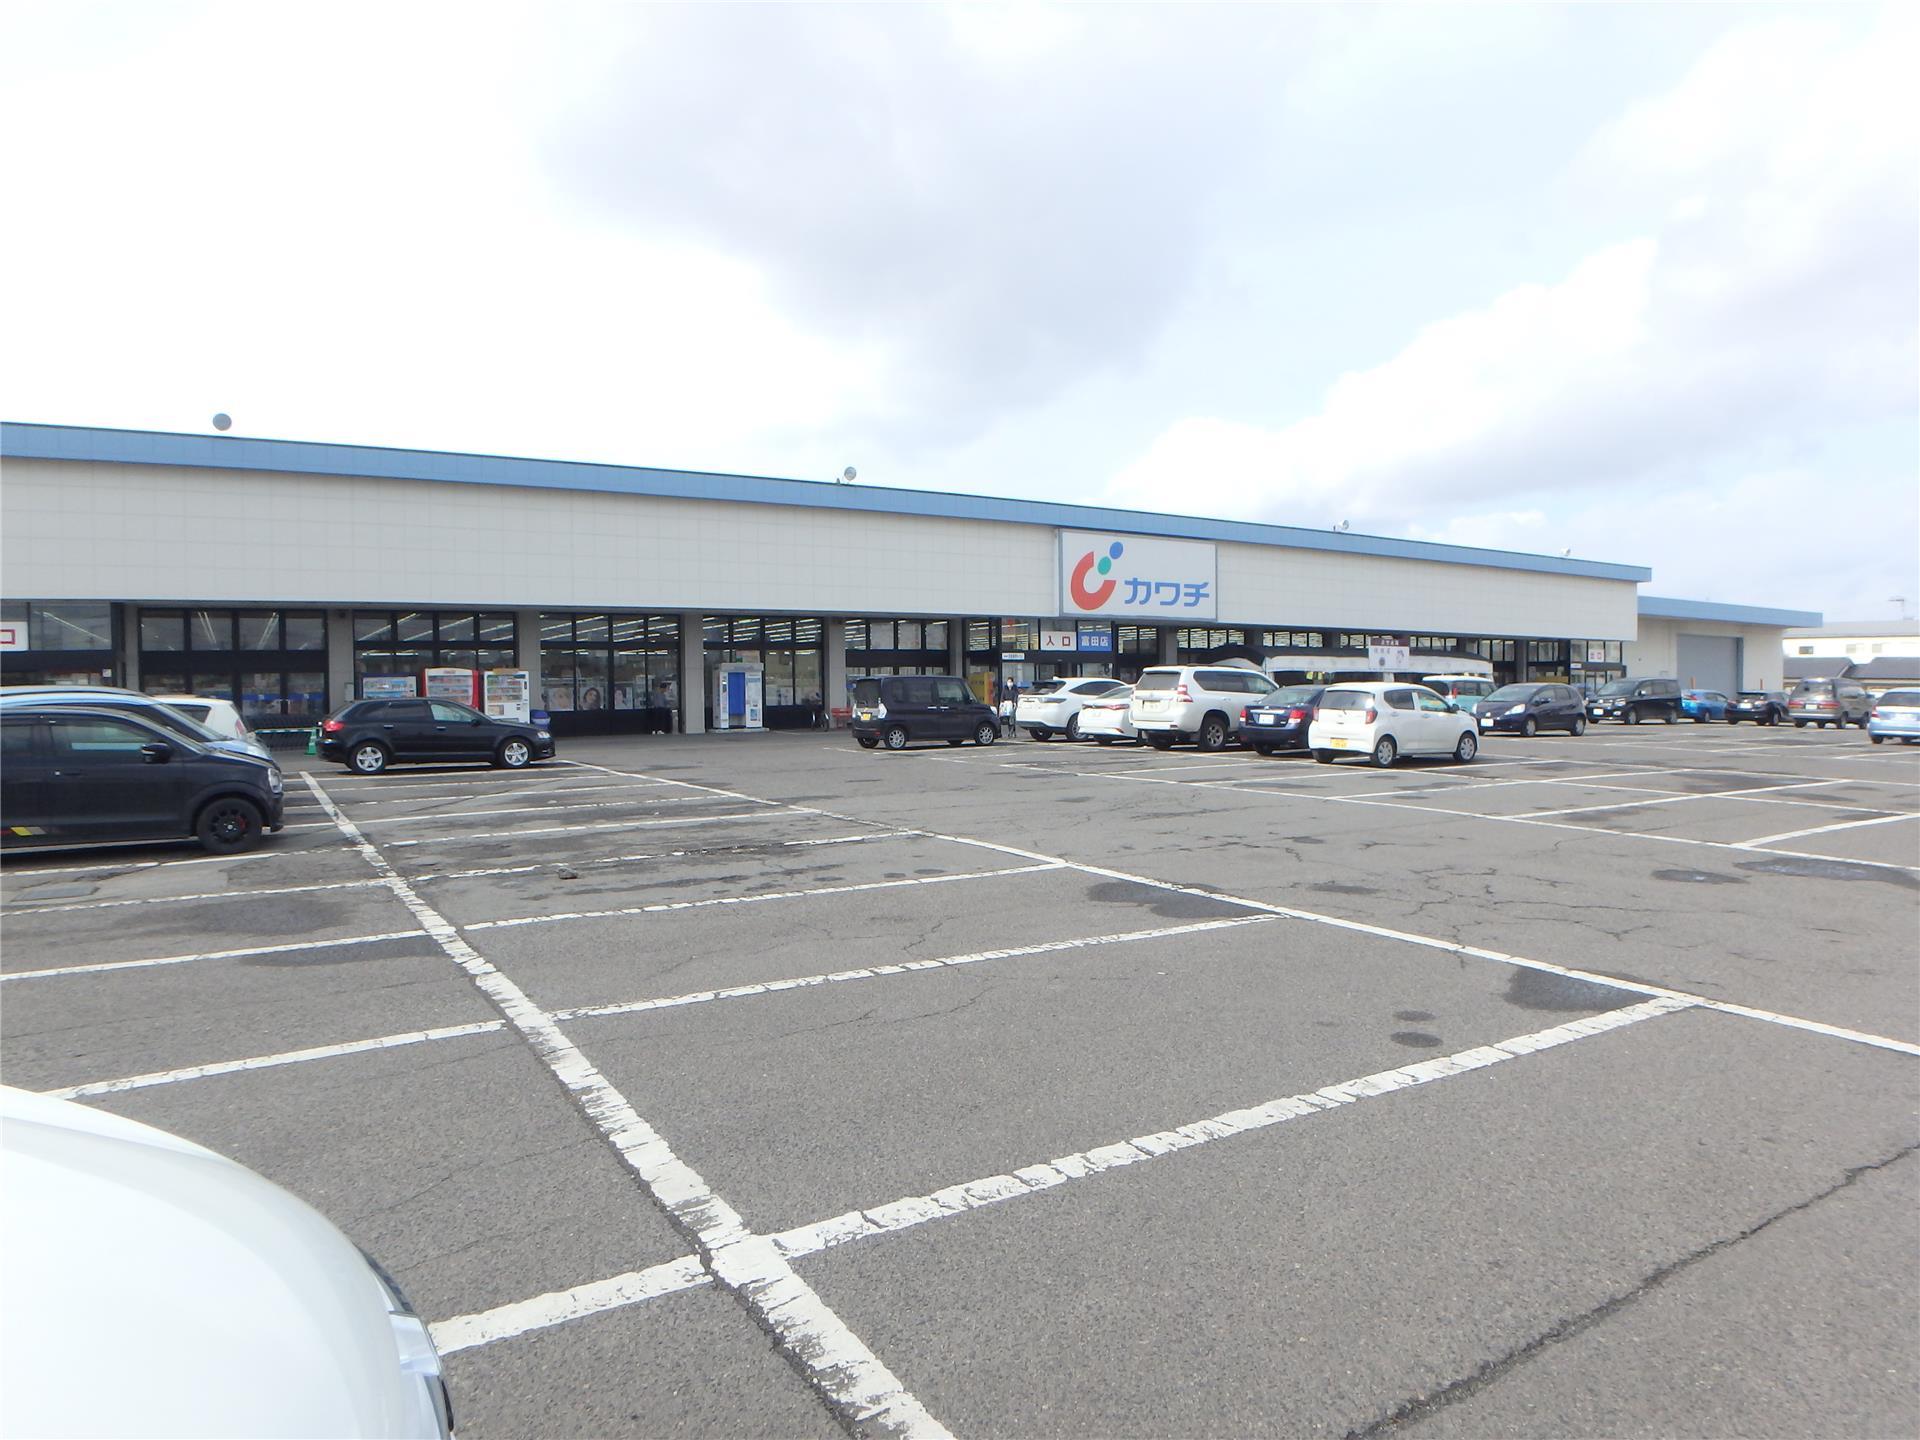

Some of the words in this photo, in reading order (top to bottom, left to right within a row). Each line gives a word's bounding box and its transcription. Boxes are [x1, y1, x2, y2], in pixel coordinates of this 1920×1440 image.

[1124, 577, 1210, 607] カワチ
[1046, 635, 1071, 647] 入口
[1081, 635, 1109, 647] 富田店
